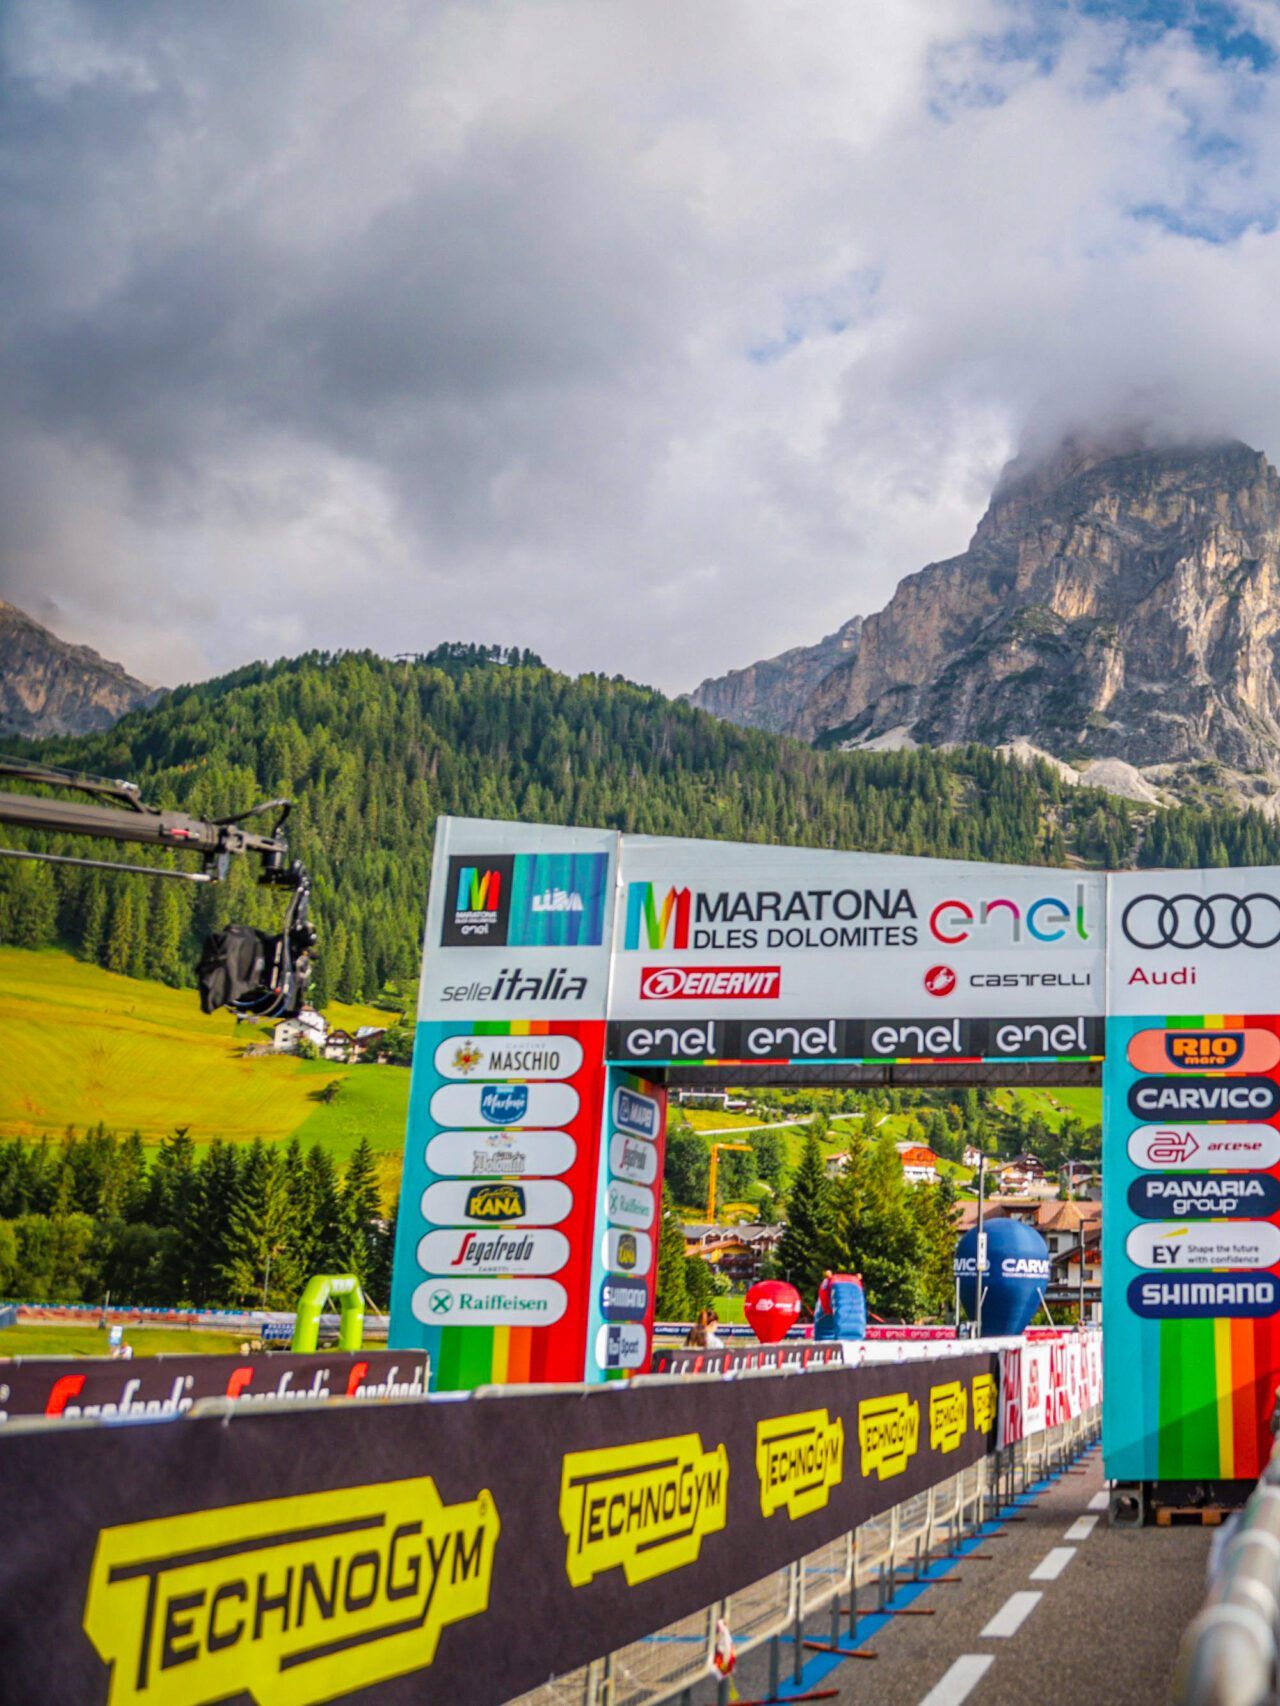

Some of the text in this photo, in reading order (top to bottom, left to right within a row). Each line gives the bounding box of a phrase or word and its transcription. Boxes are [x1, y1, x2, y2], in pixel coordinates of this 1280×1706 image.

[695, 889, 918, 922] MARATONA
[929, 884, 1088, 943] enel
[693, 926, 918, 950] DLES DOLOMITES
[683, 972, 779, 995] ENERVIT
[1128, 966, 1196, 985] Audi
[626, 1020, 716, 1057] enel
[748, 1020, 838, 1055] enel
[871, 1019, 962, 1054] enel
[996, 1017, 1087, 1053] enel
[1173, 1038, 1237, 1056] RIO
[488, 1051, 560, 1071] MASCHIO
[1136, 1087, 1274, 1109] CARVICO
[1208, 1142, 1262, 1151] arcese
[1146, 1180, 1265, 1198] PANARIA
[470, 1198, 522, 1216] RANA
[1173, 1198, 1237, 1215] group
[451, 1233, 534, 1266] Segafredo
[1153, 1244, 1181, 1264] EY
[1187, 1244, 1259, 1256] Shape the future
[1187, 1254, 1259, 1264] with confidence
[459, 1293, 548, 1311] Raiffeisen
[1142, 1282, 1274, 1305] SHIMANO
